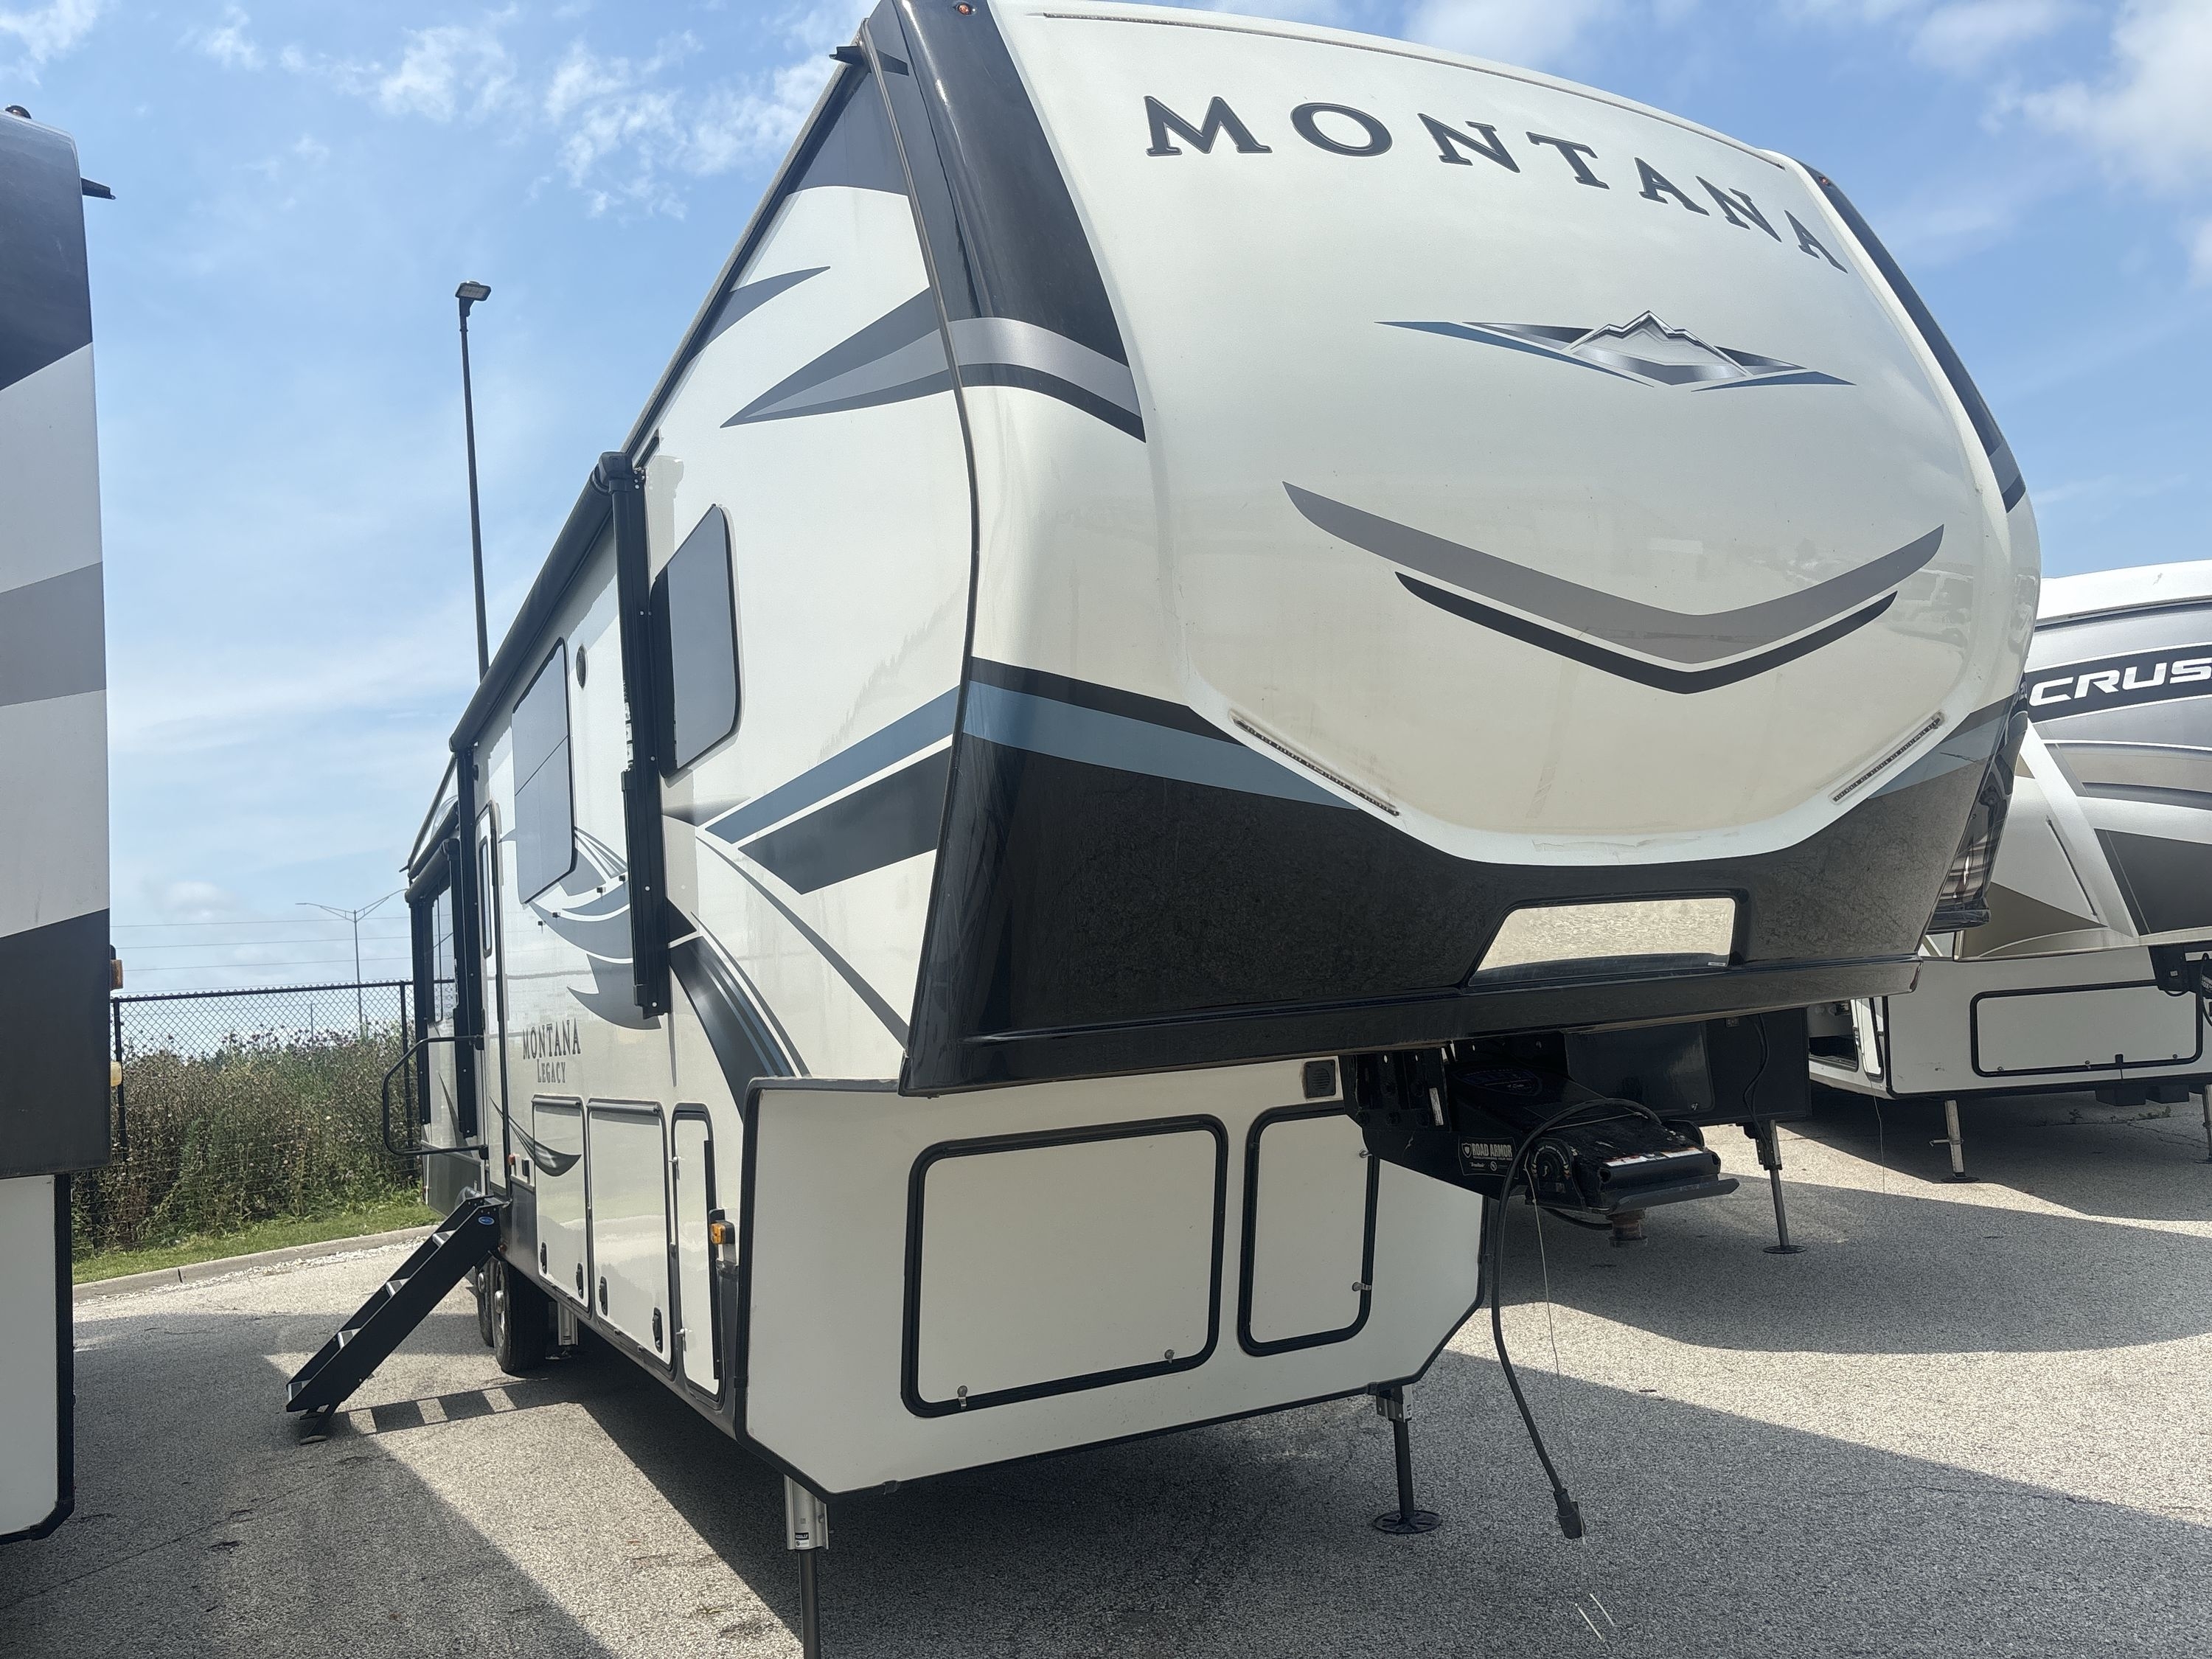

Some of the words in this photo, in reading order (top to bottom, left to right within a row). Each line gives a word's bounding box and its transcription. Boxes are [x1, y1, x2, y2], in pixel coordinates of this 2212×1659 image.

[1144, 95, 1848, 274] MONTANA
[2028, 657, 2212, 707] CRUS
[523, 1017, 581, 1060] MONTANA
[536, 1059, 566, 1083] LEGACY
[1472, 1143, 1489, 1156] ROAD
[1489, 1144, 1513, 1158] ARMOR
